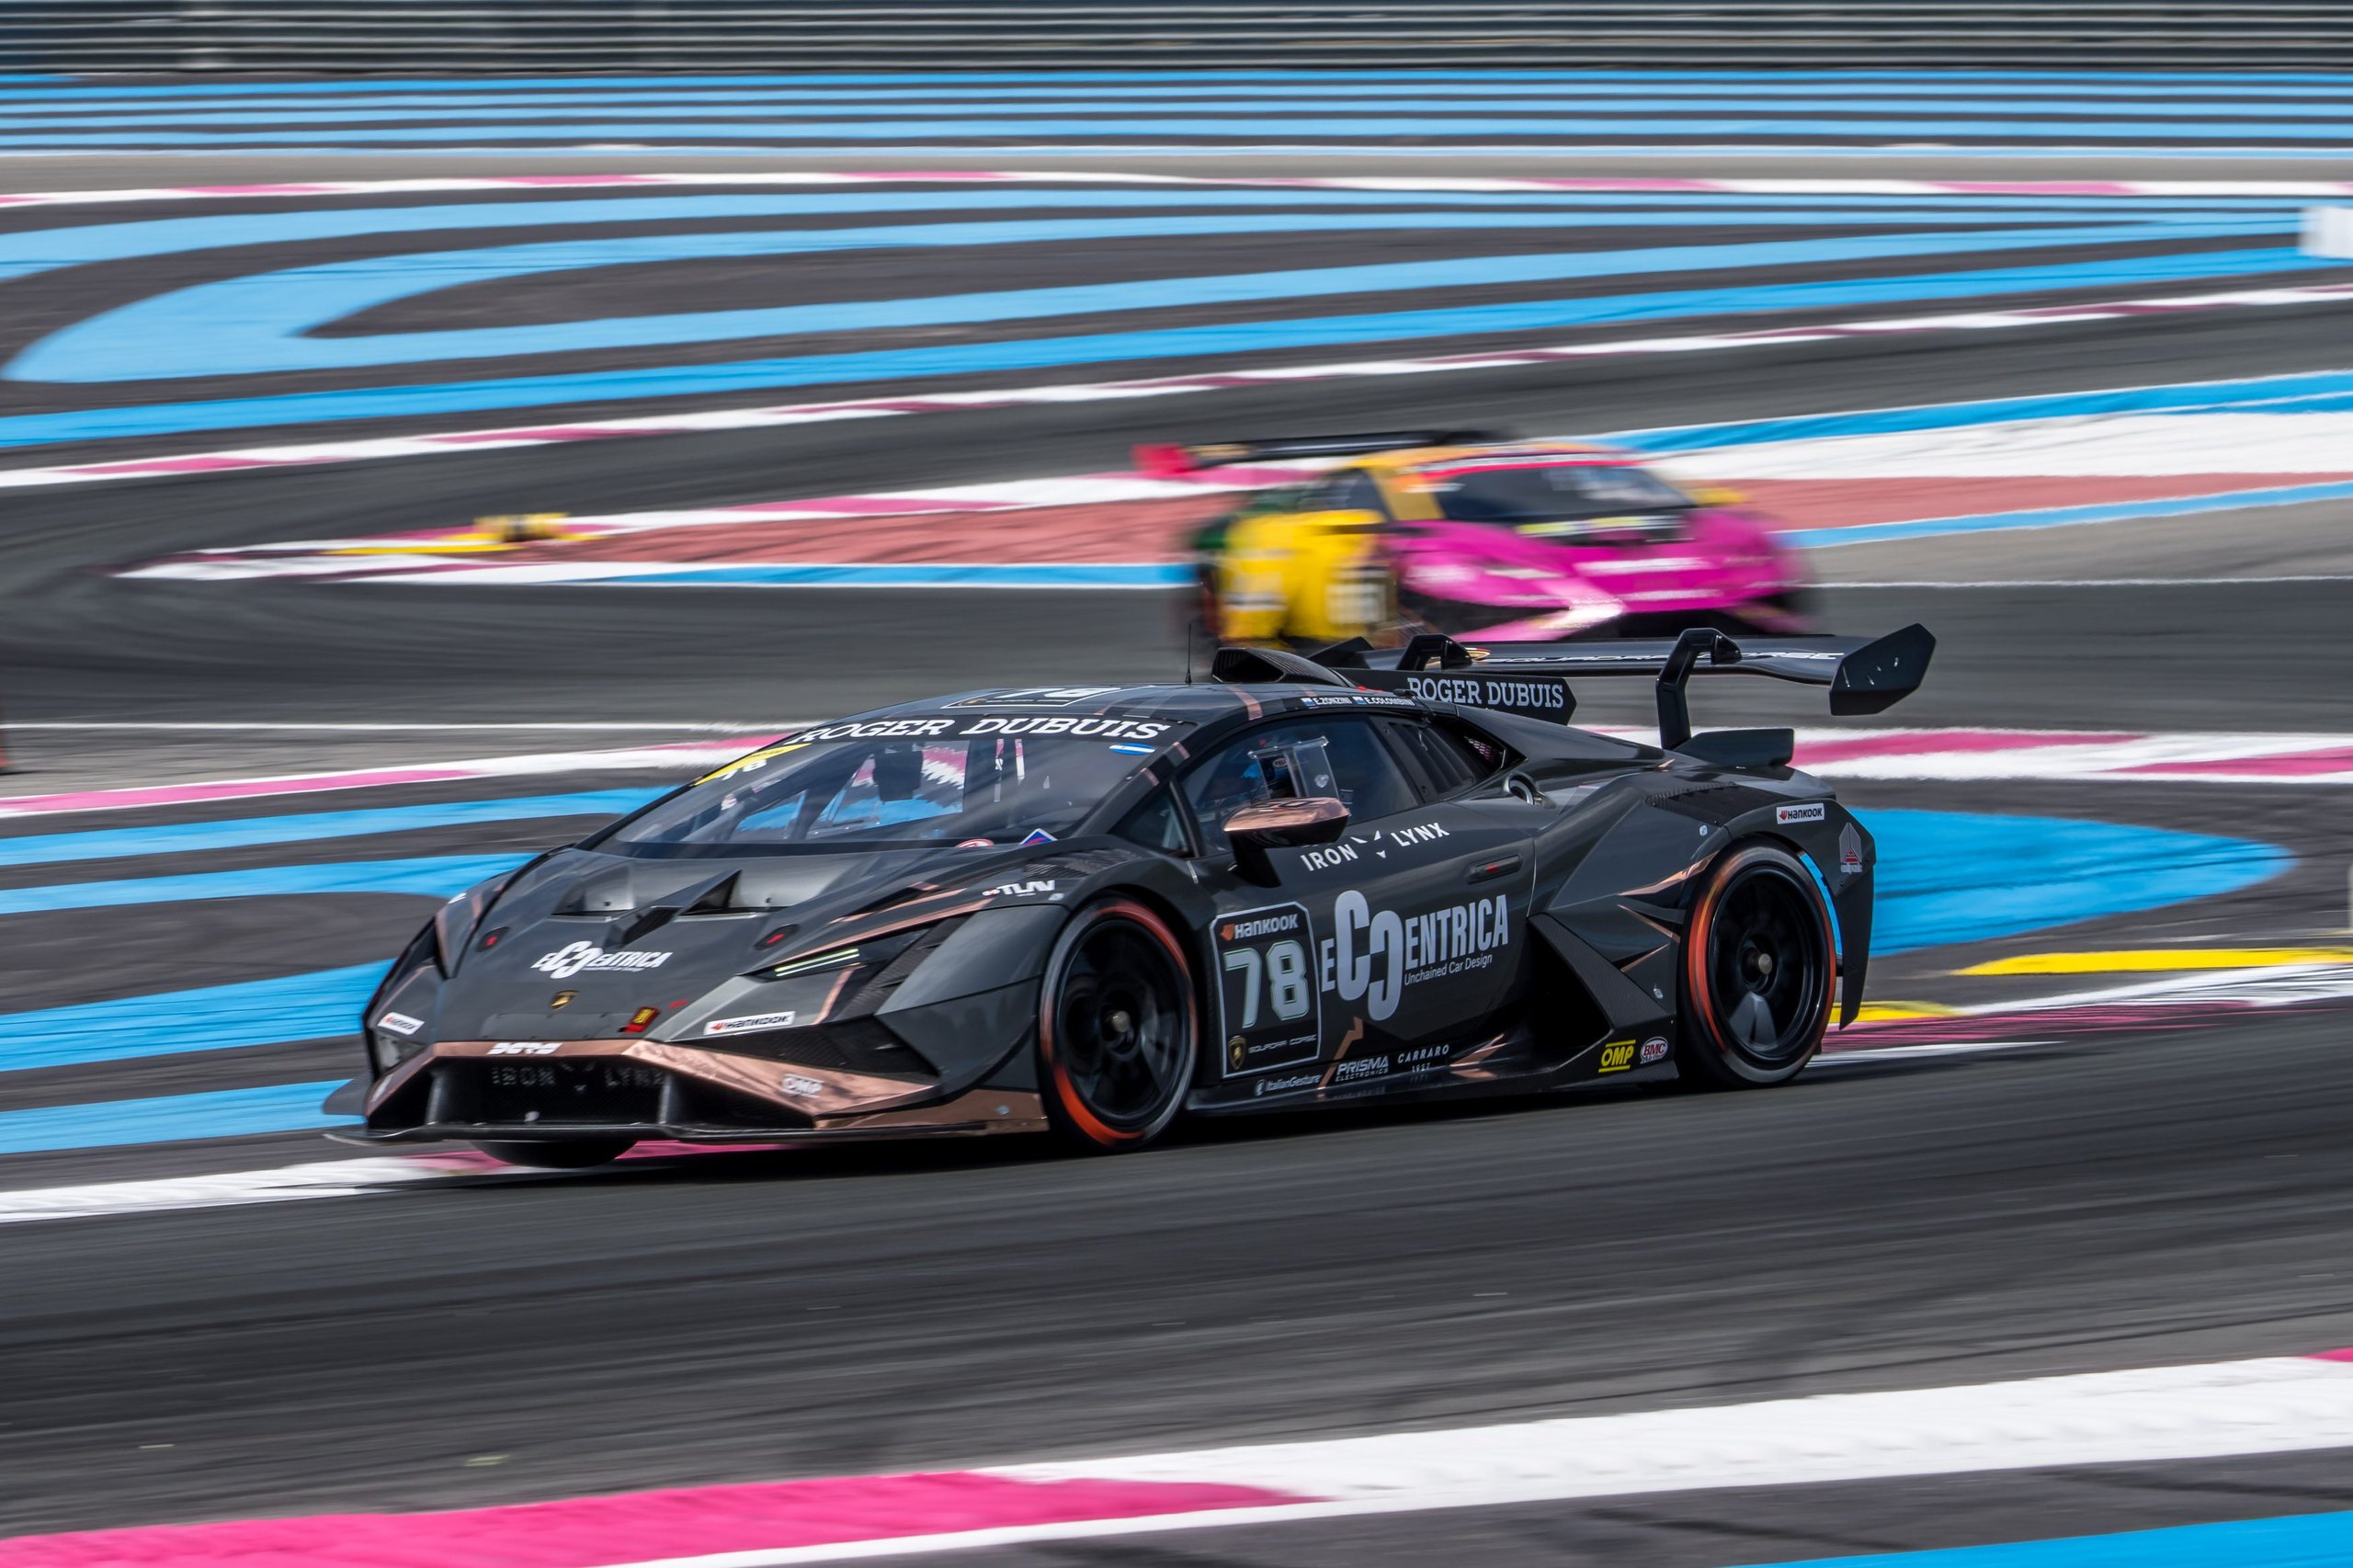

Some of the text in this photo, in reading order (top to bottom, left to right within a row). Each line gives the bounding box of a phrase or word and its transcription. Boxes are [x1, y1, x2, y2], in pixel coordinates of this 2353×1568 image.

[1407, 677, 1564, 709] ROGER DUBUIS
[783, 718, 1171, 745] ROGER DUBUIS
[1301, 823, 1450, 871] IRON LYNX
[1404, 953, 1493, 985] Unchained Car Design
[1223, 939, 1310, 1028] 78
[1397, 1044, 1449, 1064] CARRARO
[1601, 1045, 1634, 1066] OMP
[1643, 1042, 1665, 1056] BMC
[1336, 1055, 1389, 1076] PRISMA
[1336, 1068, 1389, 1083] ELECTRONICS
